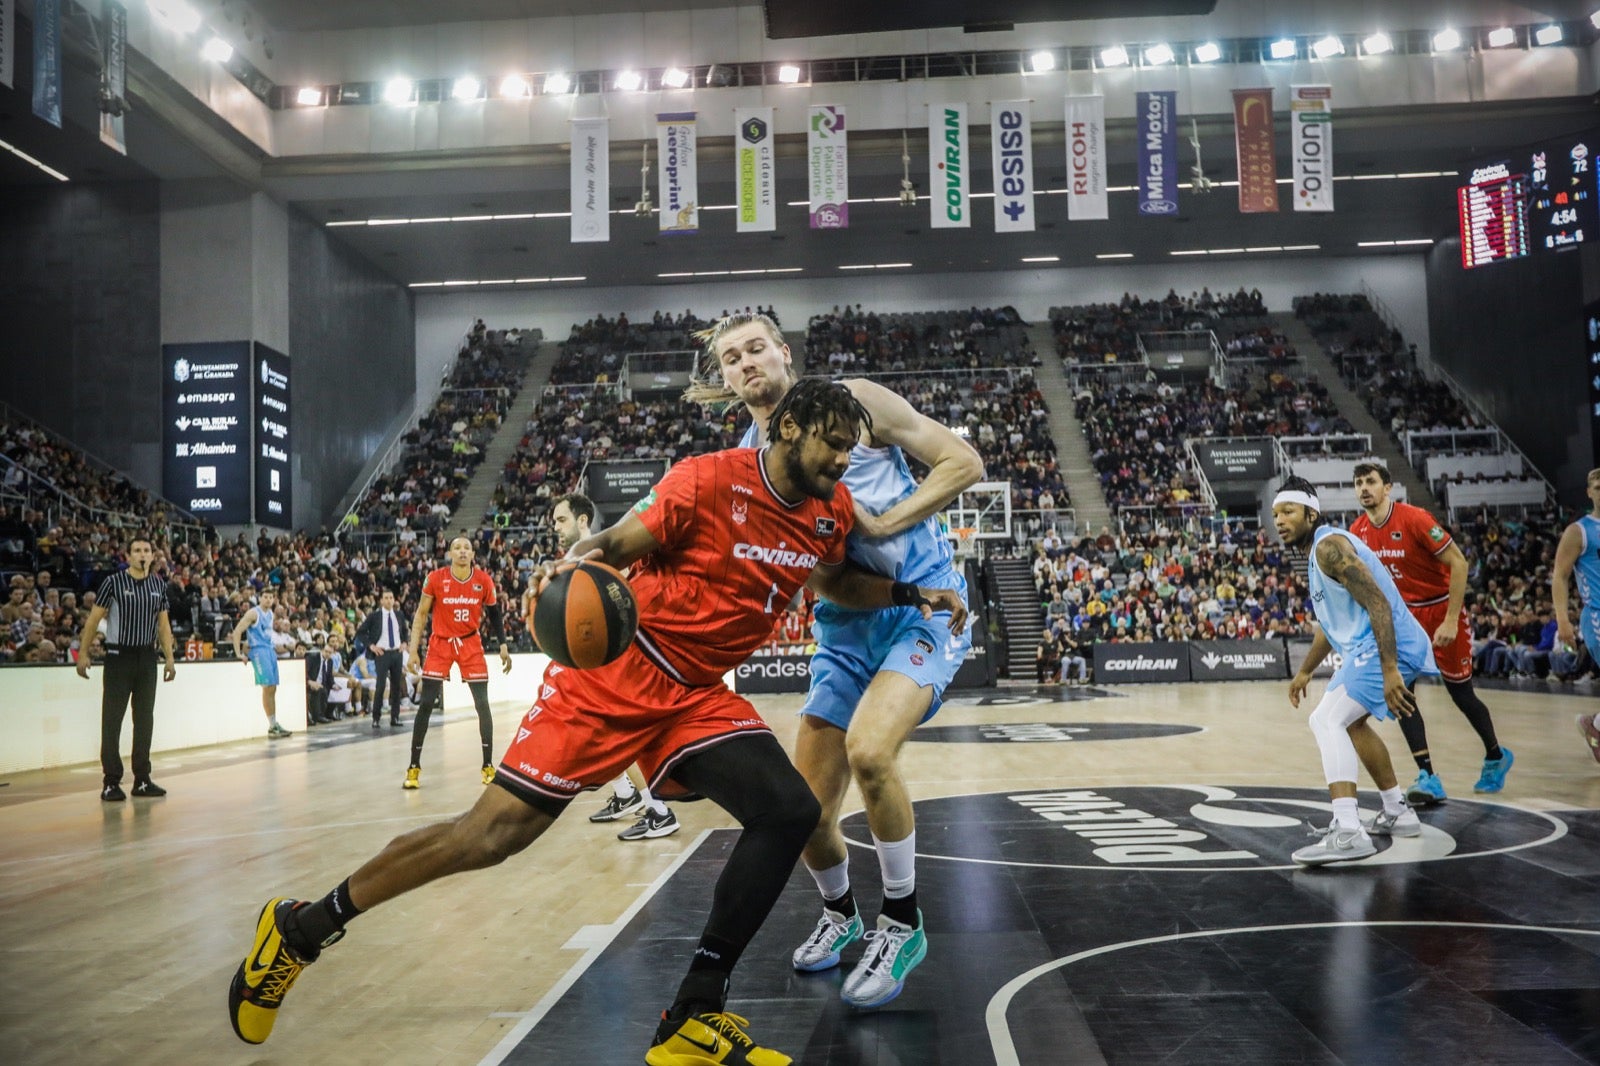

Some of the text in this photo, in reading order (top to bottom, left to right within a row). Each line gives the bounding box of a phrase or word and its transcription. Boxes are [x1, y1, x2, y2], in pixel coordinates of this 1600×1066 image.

[1146, 93, 1163, 150] Motor
[1000, 110, 1025, 197] asisa
[1073, 122, 1088, 195] RICOH
[1298, 123, 1321, 192] orion
[666, 126, 682, 211] aeroprint
[812, 146, 823, 197] Deportes
[824, 145, 836, 201] Palacio de
[836, 145, 846, 191] Farmacia
[938, 108, 961, 221] COVIRAN
[1260, 129, 1274, 208] ANTONIO
[1573, 159, 1588, 173] 72
[762, 146, 770, 206] cidesur
[1147, 153, 1163, 199] Mica
[742, 148, 754, 222] ASCENSORES
[1551, 208, 1577, 225] 4:54
[191, 363, 239, 373] AYUNTAMIENTO
[204, 370, 235, 379] GRANADA
[186, 392, 236, 404] emasagra
[190, 441, 237, 457] Alhambra
[1210, 449, 1262, 458] AYUNTAMIENTO
[1224, 457, 1258, 465] GRANADA
[604, 471, 654, 480] AYUNTAMIENTO
[618, 479, 650, 487] GRANADA
[731, 484, 753, 496] vive
[191, 499, 222, 509] GOGSA
[764, 582, 779, 614] 1
[453, 608, 470, 623] 32
[1104, 654, 1178, 671] COVIRAN
[1222, 653, 1276, 663] CAJA RURAL
[519, 761, 540, 776] vive
